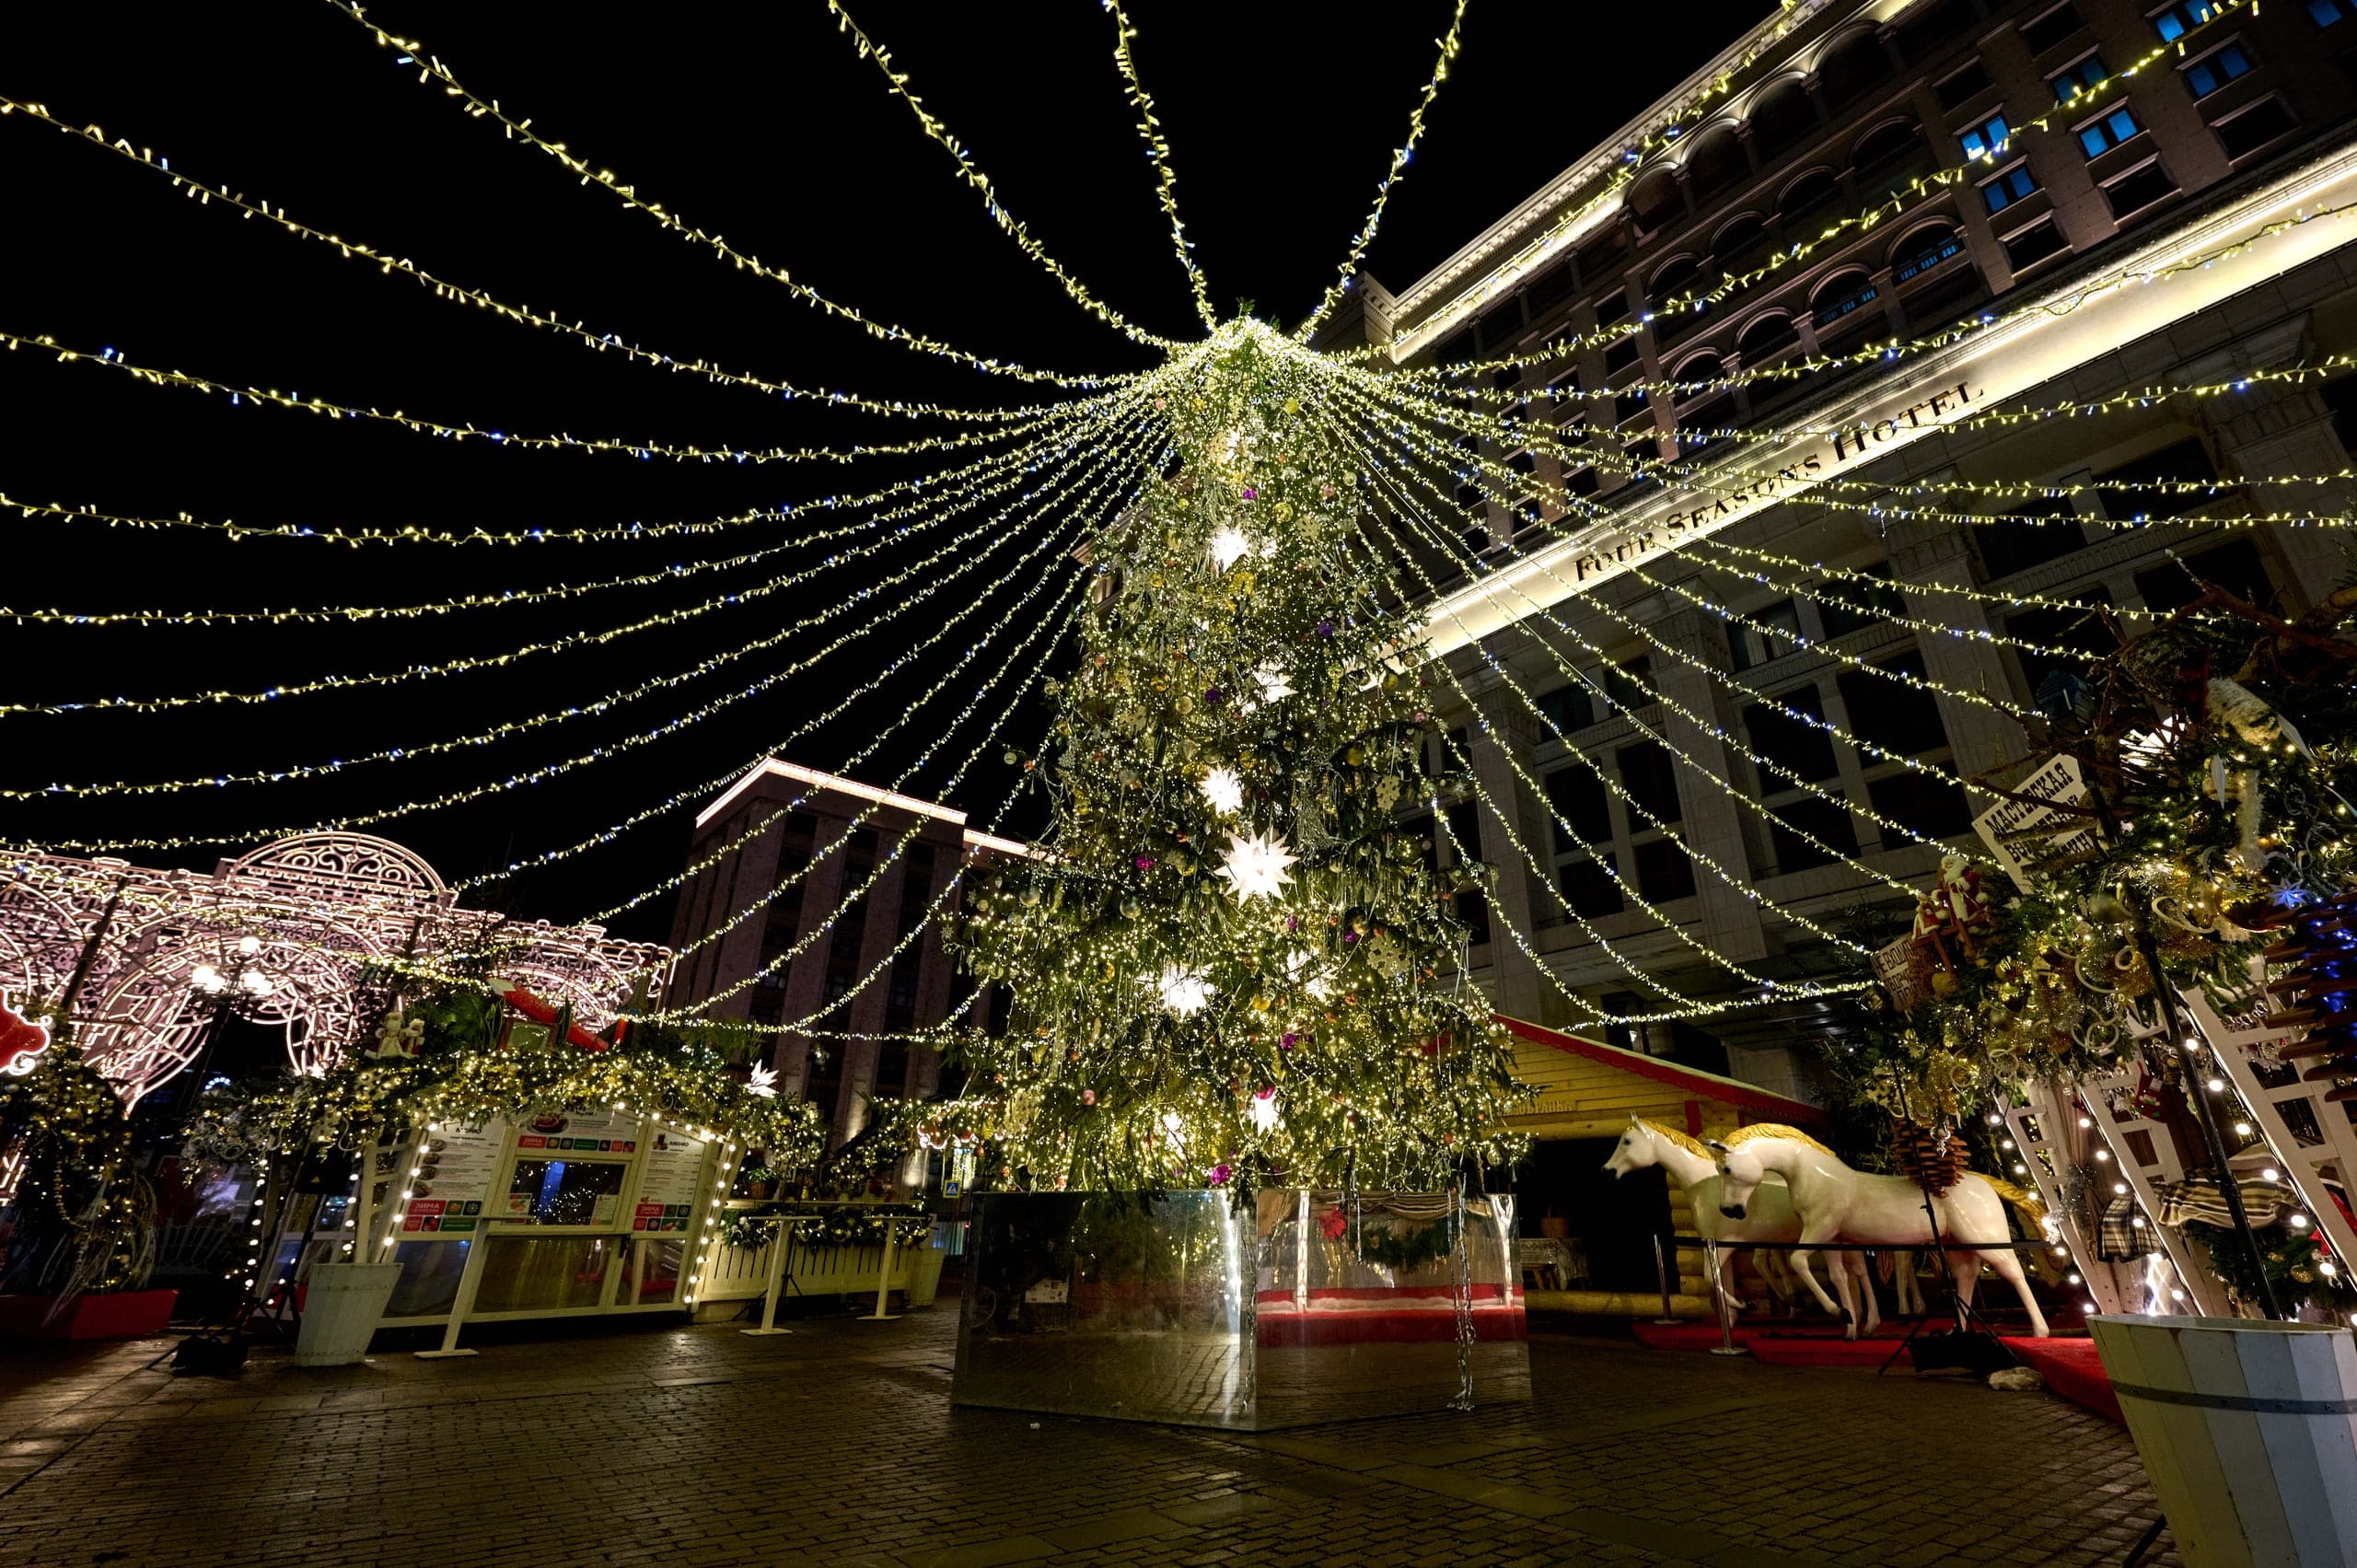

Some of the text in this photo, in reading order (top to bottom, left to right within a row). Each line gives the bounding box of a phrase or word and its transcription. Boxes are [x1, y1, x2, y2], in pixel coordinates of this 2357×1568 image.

[1573, 381, 1984, 582] FOUR SEASONS HOTEL
